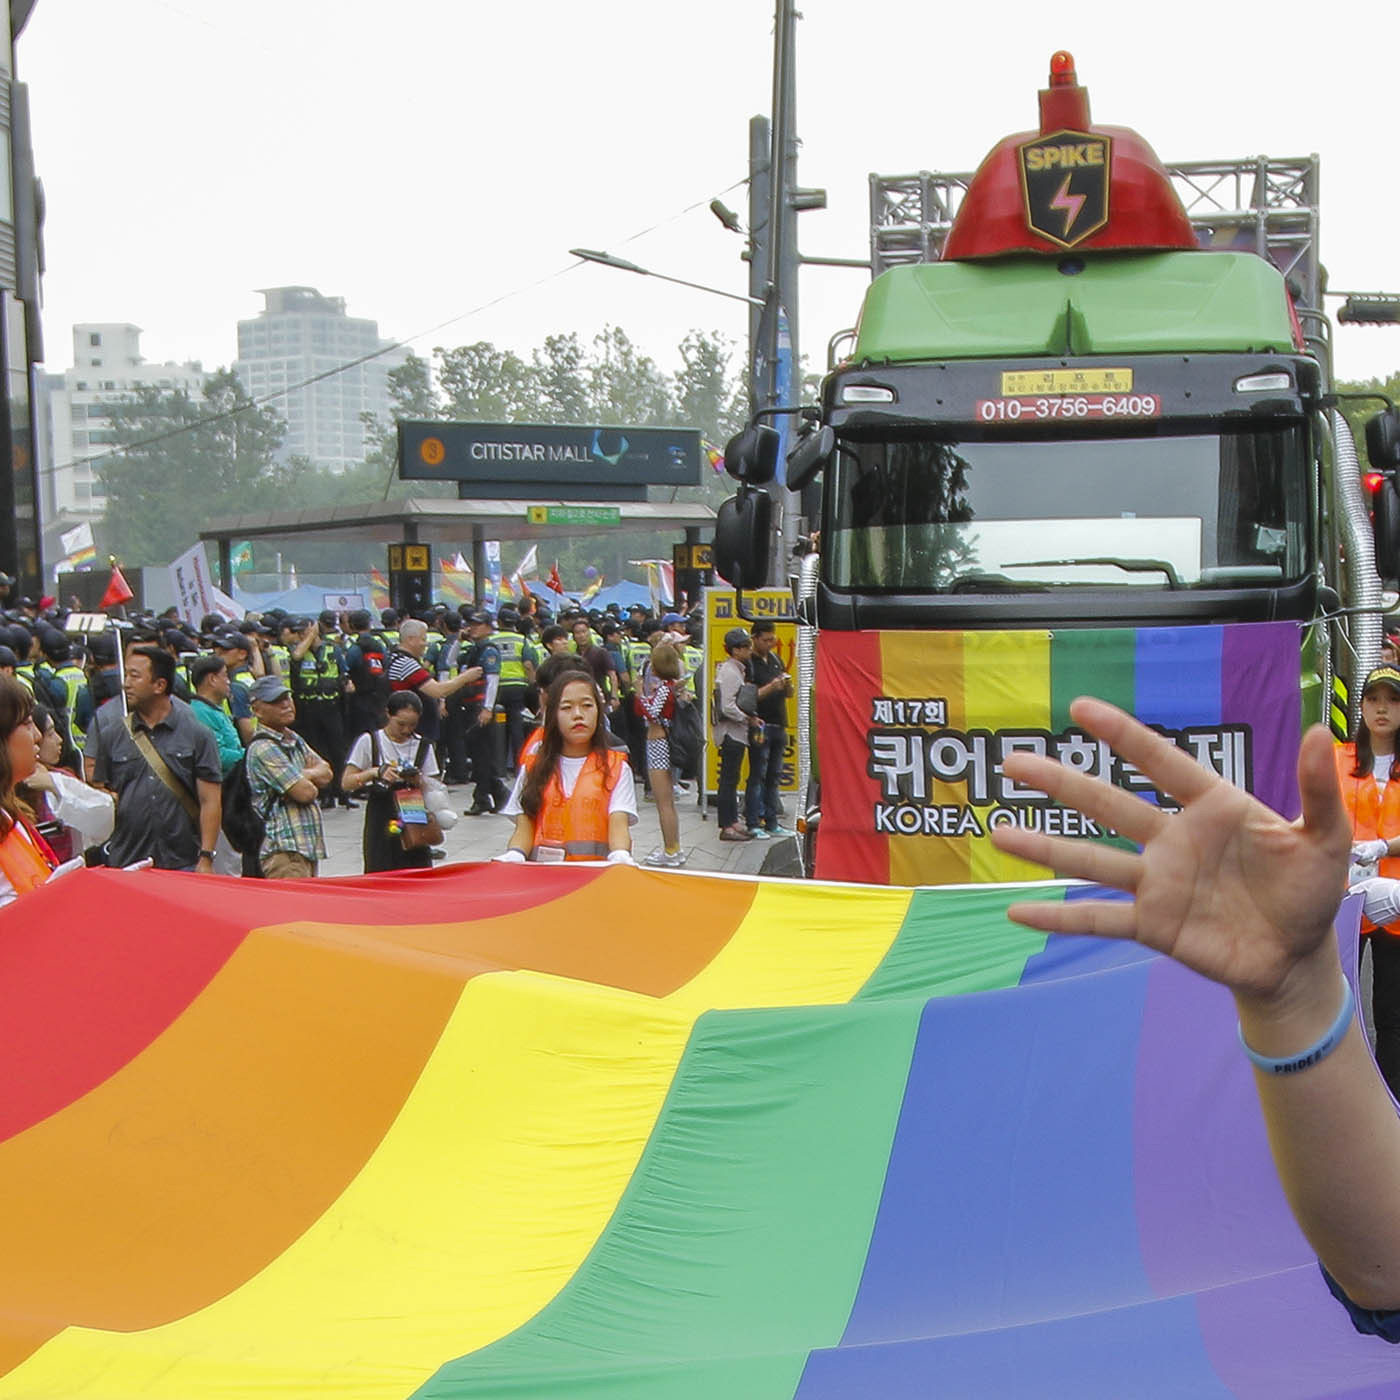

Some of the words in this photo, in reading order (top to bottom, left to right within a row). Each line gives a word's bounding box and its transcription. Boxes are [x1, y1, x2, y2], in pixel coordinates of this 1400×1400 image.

[1027, 142, 1105, 170] SPIKE
[981, 397, 1156, 420] 010-3756-6409
[471, 442, 546, 461] CITISTAR
[550, 444, 594, 463] MALL
[873, 700, 946, 725] 제17회
[875, 804, 983, 836] KOREA
[989, 807, 1100, 836] QUEER
